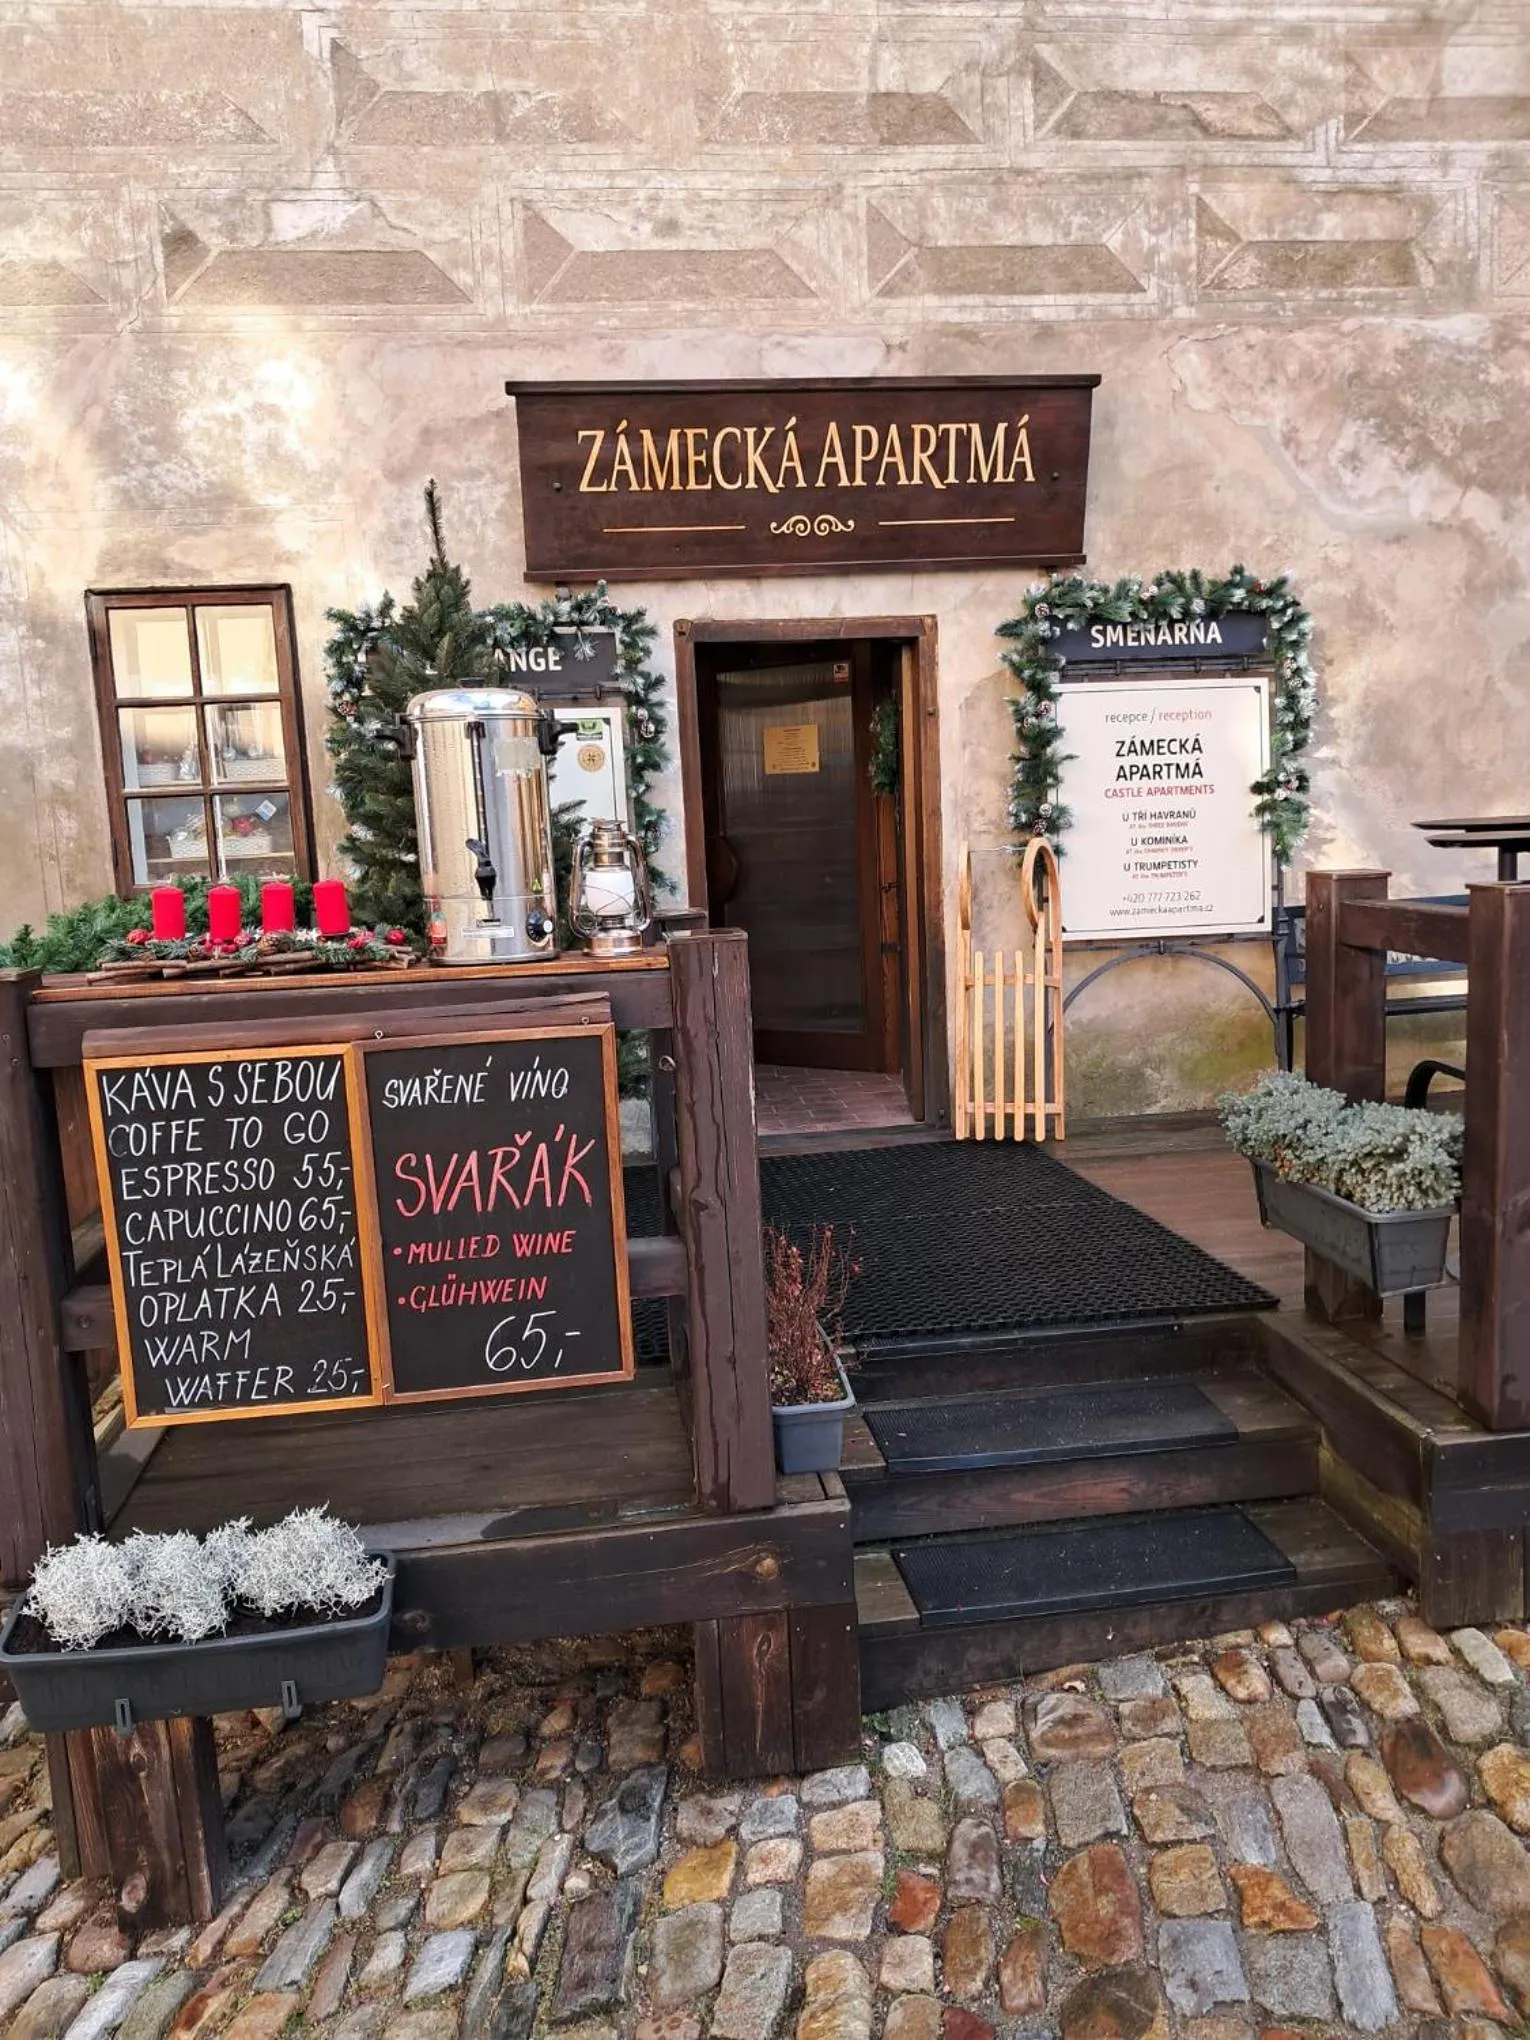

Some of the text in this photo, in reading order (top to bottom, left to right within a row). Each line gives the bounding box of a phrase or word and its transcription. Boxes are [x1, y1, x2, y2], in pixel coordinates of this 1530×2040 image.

[576, 413, 1036, 494] ZÁMECKÁ APARTMÁ
[1105, 711, 1148, 725] recepce
[1159, 708, 1212, 723] reception
[1115, 733, 1203, 757] ZÁMECKÁ
[1115, 758, 1204, 782] APARTMÁ
[1104, 784, 1215, 799] CASTLE APARTMENTS
[1122, 813, 1129, 822] U
[1131, 837, 1138, 846] U
[1123, 859, 1199, 872] U TRUMPETISTY
[102, 1060, 341, 1117] KÁVA S SEBOU
[382, 1055, 570, 1109] SVAŘENÉ VÍNO
[108, 1109, 329, 1158] COFFE TO GO
[121, 1157, 276, 1201] ESPRESSO
[394, 1123, 596, 1218] SVAŘÁK
[125, 1198, 292, 1246] CAPUCCINO
[512, 1229, 577, 1258] WINE
[122, 1244, 211, 1288] TEPLÁ
[139, 1282, 282, 1329] OPLATKA
[144, 1328, 251, 1368] WARM
[165, 1365, 295, 1407] WAFFER
